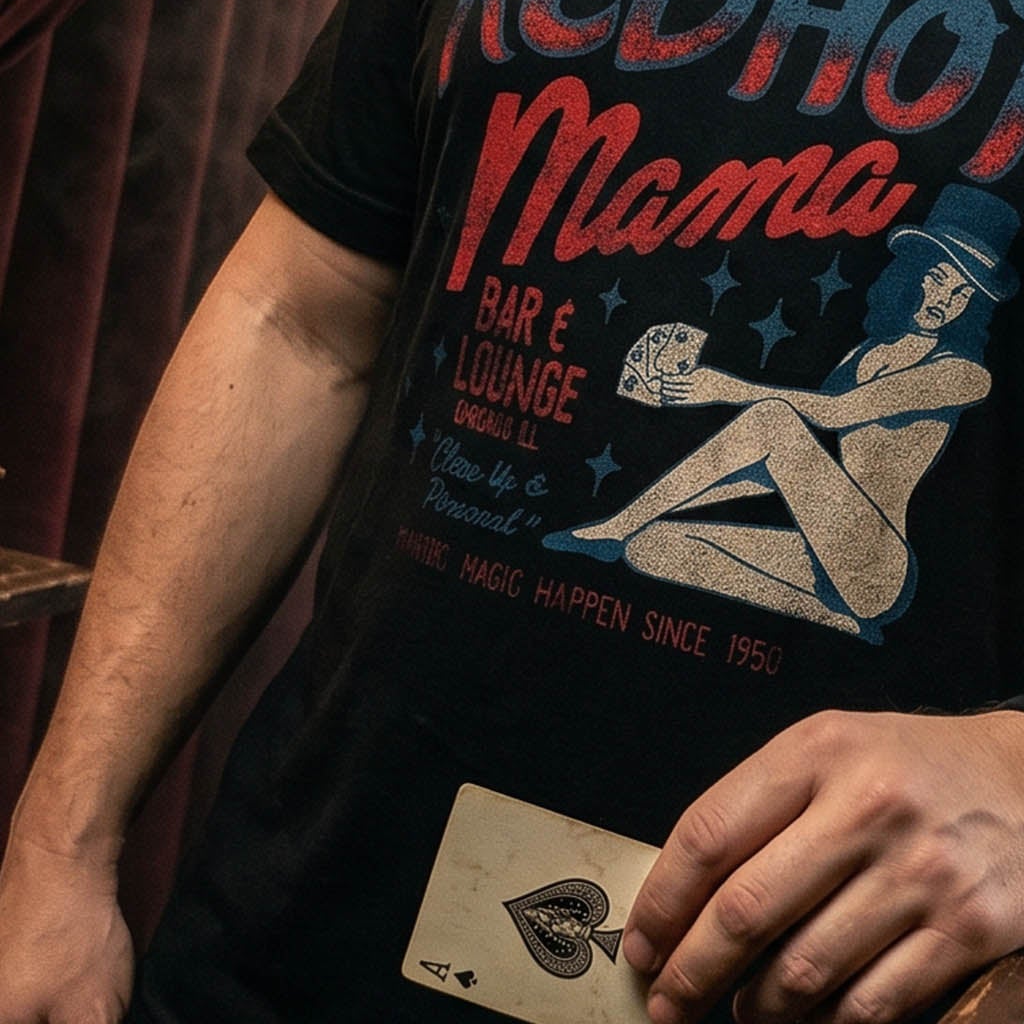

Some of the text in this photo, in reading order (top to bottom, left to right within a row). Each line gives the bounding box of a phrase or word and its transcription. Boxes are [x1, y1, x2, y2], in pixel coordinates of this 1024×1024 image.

[446, 75, 919, 292] Mama
[474, 275, 545, 347] BAR
[453, 334, 589, 424] LOUNGE
[459, 553, 783, 676] MAGIC HAPPEN SINCE 1950
[419, 959, 452, 983] A
